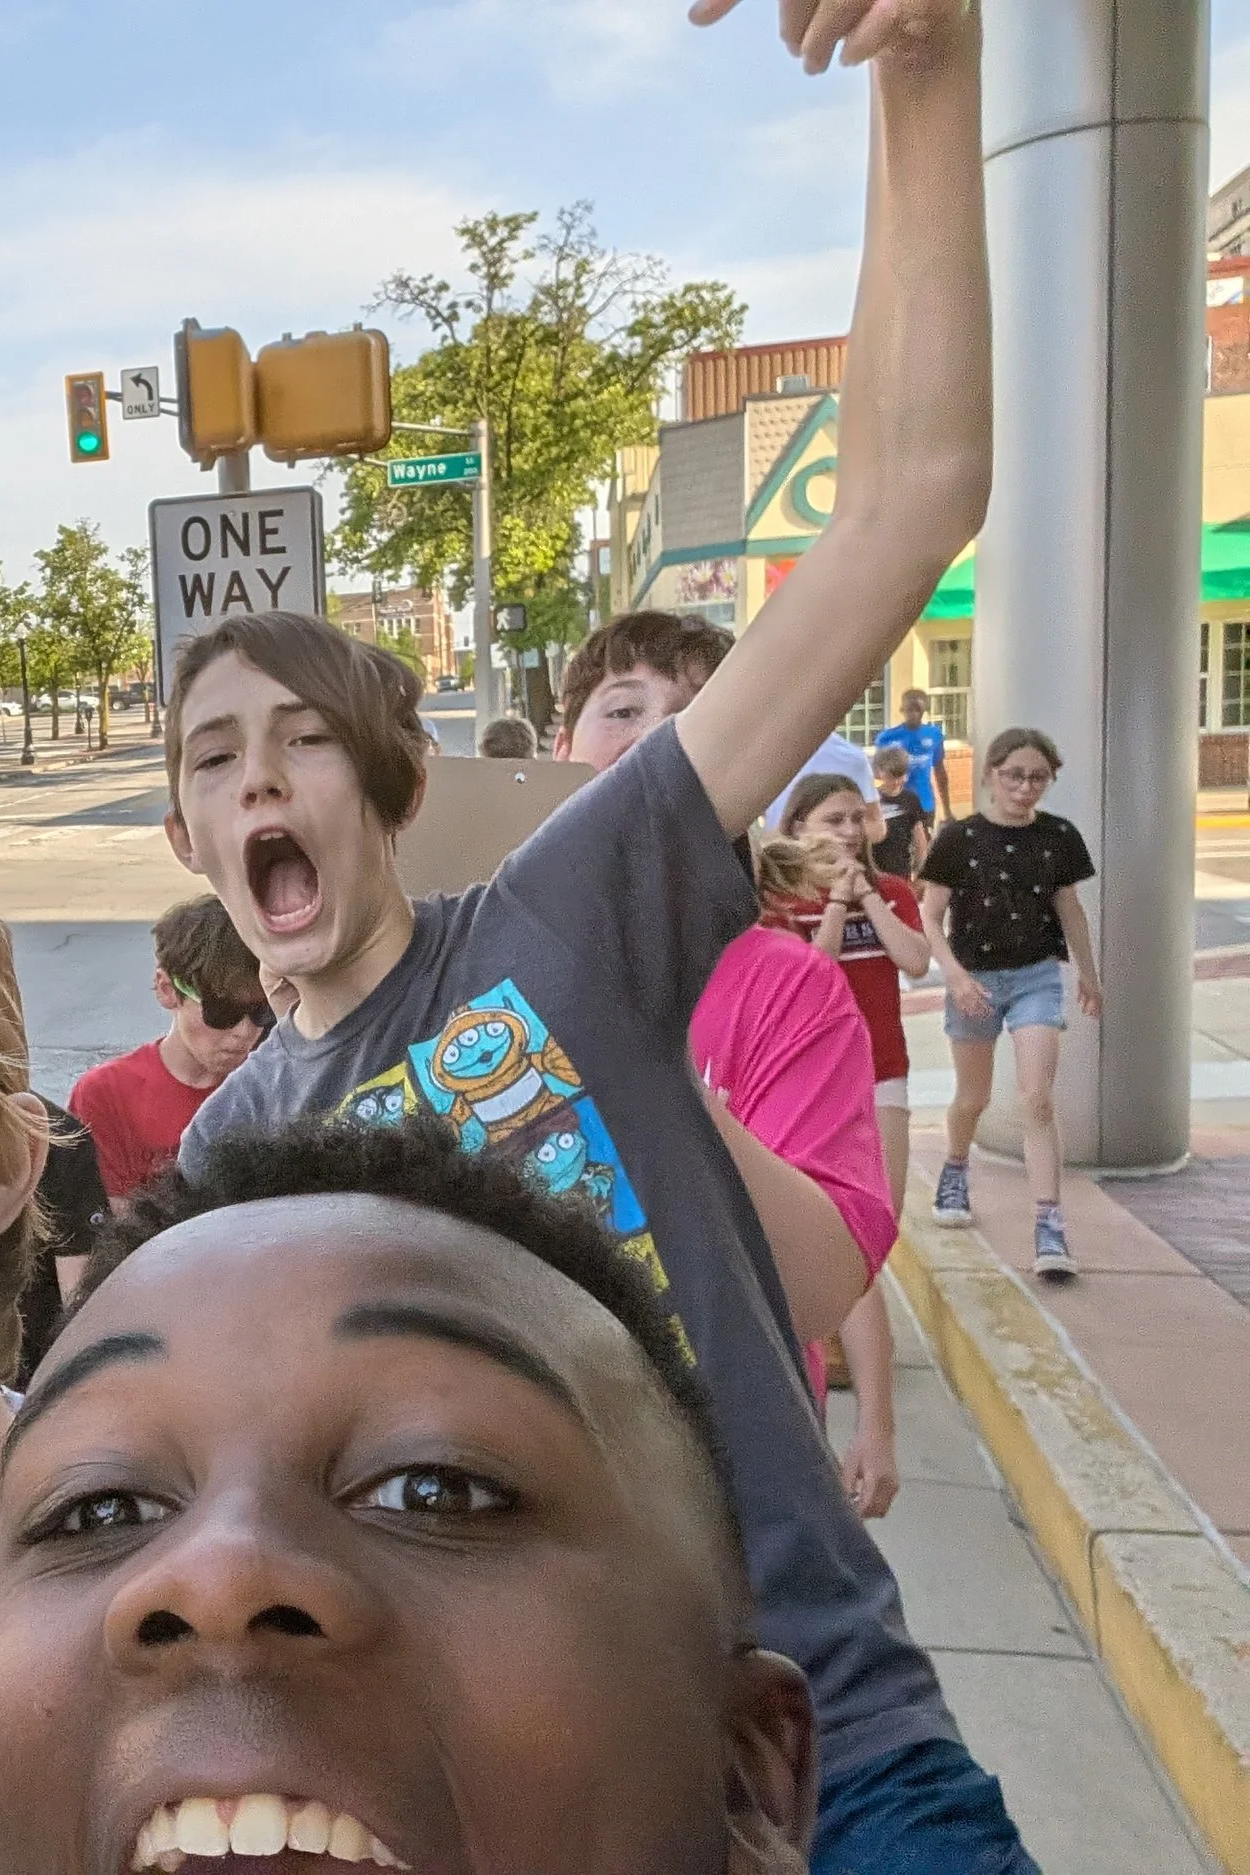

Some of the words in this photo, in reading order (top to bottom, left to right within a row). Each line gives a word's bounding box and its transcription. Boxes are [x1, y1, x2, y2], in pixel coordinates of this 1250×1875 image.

[127, 402, 155, 415] ONLY
[393, 462, 447, 480] Wayne
[180, 508, 287, 561] ONE
[178, 565, 292, 618] WAY
